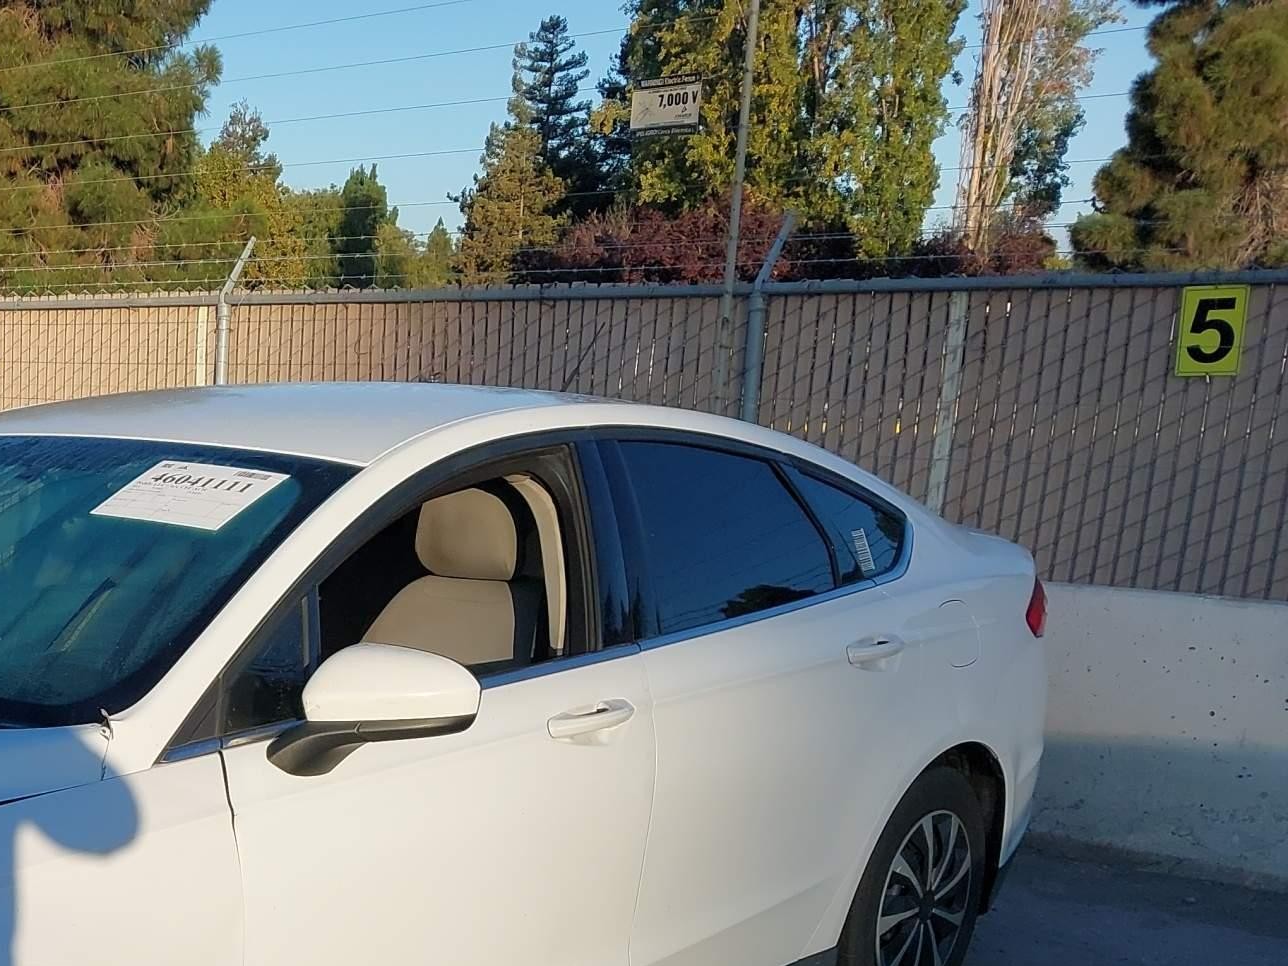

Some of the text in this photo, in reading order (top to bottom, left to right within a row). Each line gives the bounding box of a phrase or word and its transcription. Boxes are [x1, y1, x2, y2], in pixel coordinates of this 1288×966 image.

[658, 90, 698, 109] 7,000 V
[1186, 297, 1237, 364] 5
[151, 472, 254, 494] 46041111
